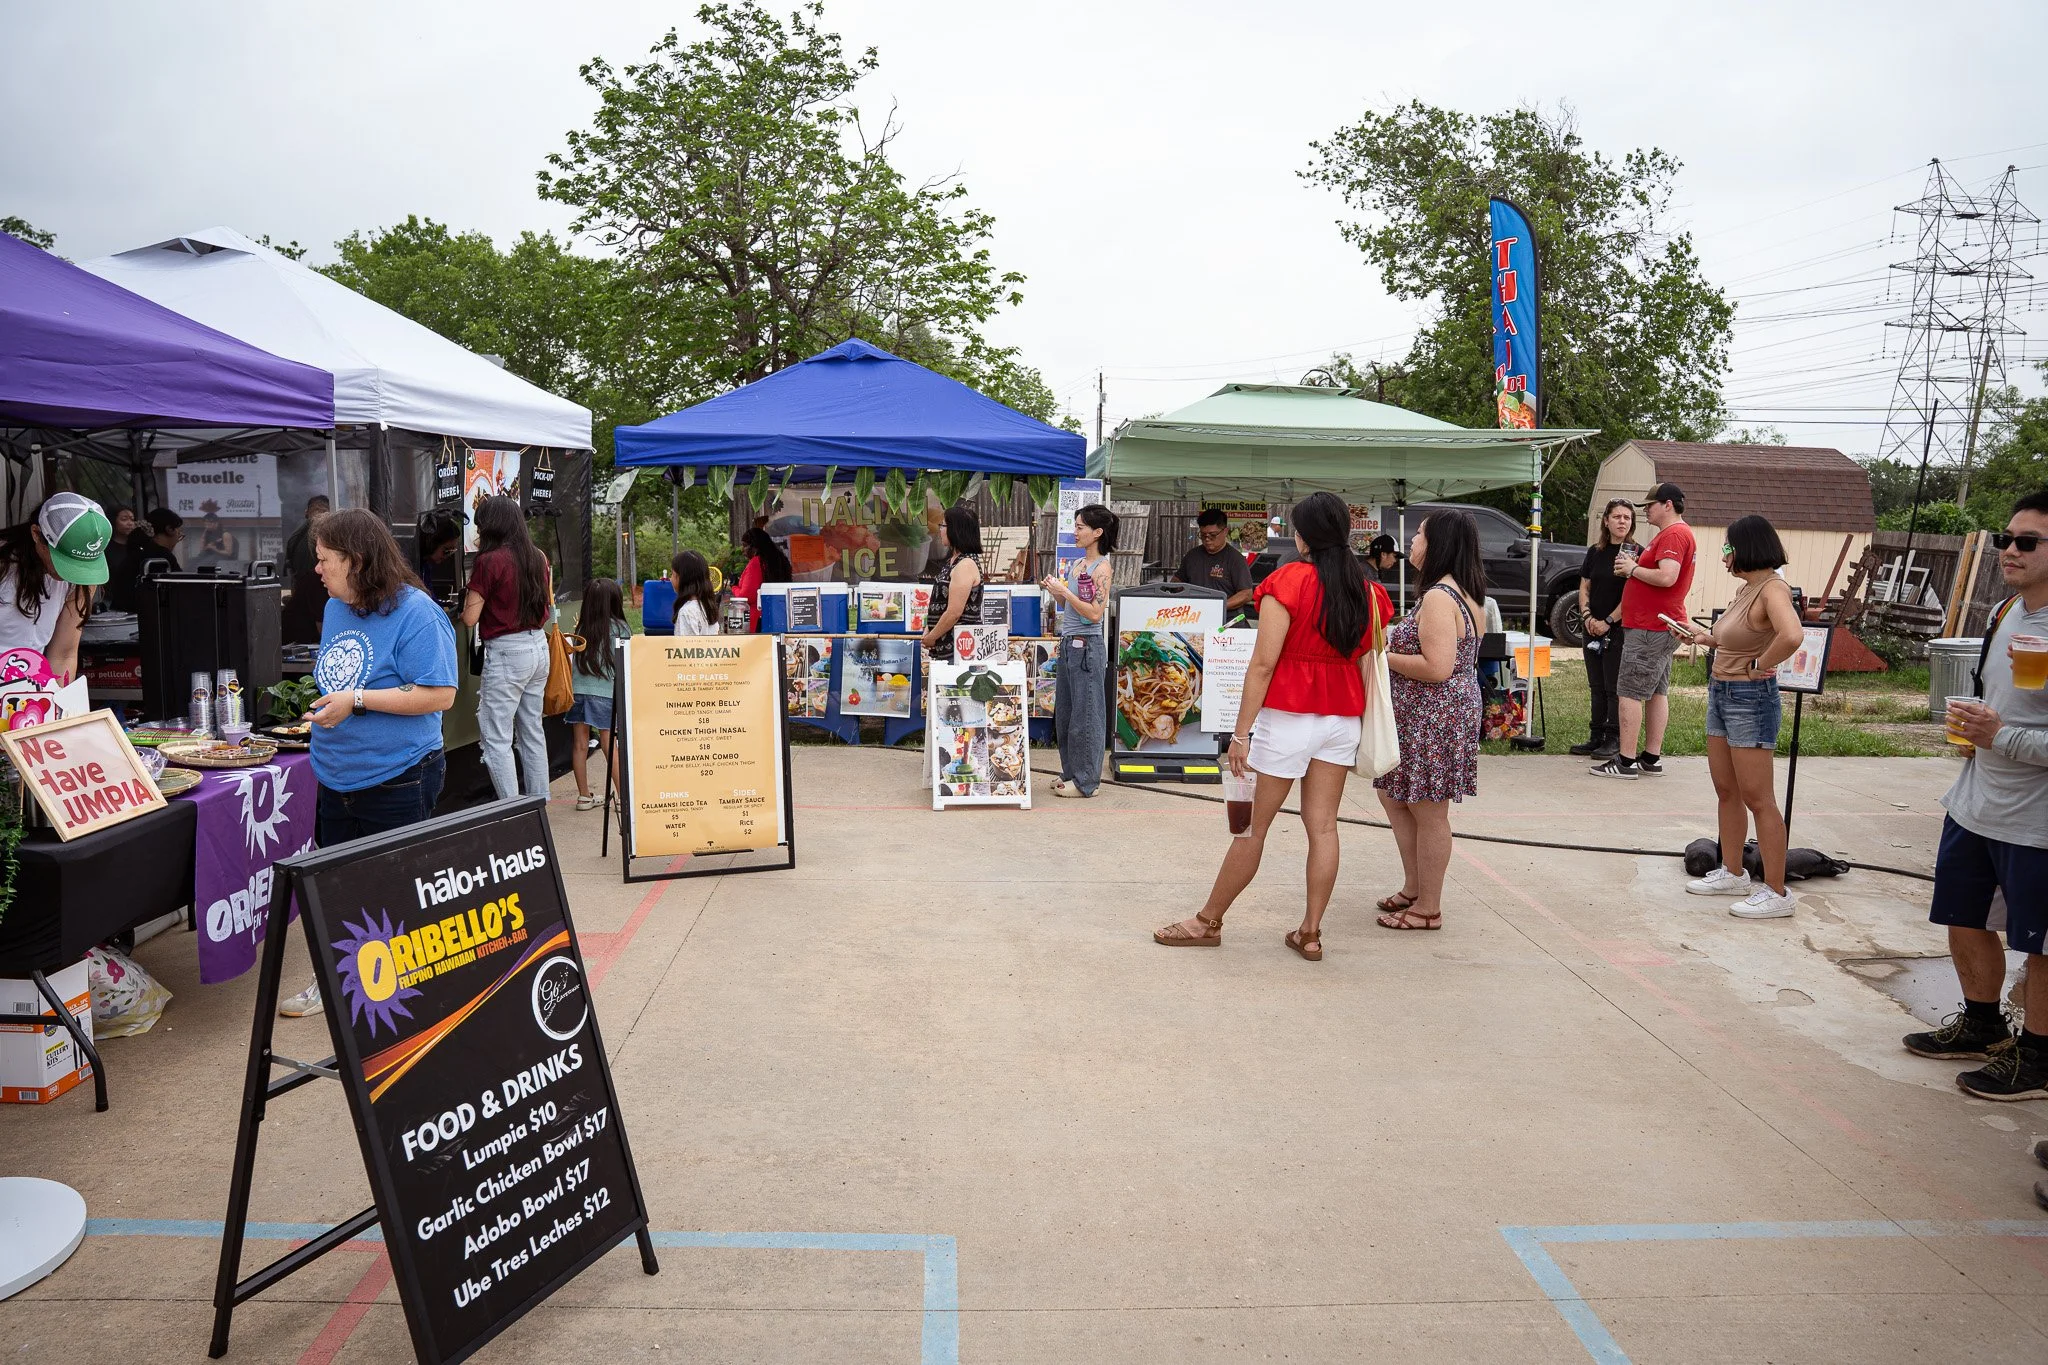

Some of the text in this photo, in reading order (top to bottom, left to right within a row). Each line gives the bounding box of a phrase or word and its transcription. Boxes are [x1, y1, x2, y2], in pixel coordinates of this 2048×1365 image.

[1496, 238, 1518, 370] THAI
[177, 472, 244, 484] Rouelle
[438, 465, 458, 478] ORDER
[534, 471, 554, 481] PICK-UP
[441, 485, 456, 497] HERE
[535, 489, 549, 498] HERE
[802, 495, 929, 527] ITALIAN
[1239, 501, 1266, 511] Sauce
[1350, 518, 1379, 530] Sauce
[841, 547, 899, 578] ICE
[1156, 605, 1191, 619] FRESH
[957, 637, 974, 651] STOP
[980, 630, 998, 650] FREE
[664, 647, 741, 660] TAMBAYAN
[977, 638, 1007, 661] SAMPLES
[331, 629, 361, 643] CROSSING
[359, 664, 374, 689] MARKE
[98, 670, 132, 680] pellicule
[677, 672, 729, 681] RICE PLATES
[666, 701, 694, 709] INIHAW
[718, 699, 741, 707] BELLY
[659, 726, 747, 736] CHICKEN THIGH INASAL
[671, 754, 710, 762] TAMBAYAN
[700, 769, 714, 777] $20
[660, 788, 757, 799] DRINKS SIDES
[66, 778, 154, 828] UMPIA
[641, 802, 678, 810] CALAMANSI
[665, 822, 686, 830] WATER
[739, 819, 754, 827] RICE
[743, 828, 752, 836] $2
[488, 844, 546, 884] haus
[357, 892, 525, 1002] ORIBELLO'S
[398, 928, 528, 990] FILIPINO HAWAIIAN KITCHEN+BAR
[46, 1044, 69, 1060] CUTLERY
[401, 1043, 583, 1162] FOOD & DRINKS
[462, 1101, 557, 1171] Lumpia $10
[417, 1106, 608, 1240] Garlic Chicken Bowl $17
[464, 1157, 590, 1260] Adobo Bowl $17
[453, 1187, 611, 1308] Ube Tres Leches $12
